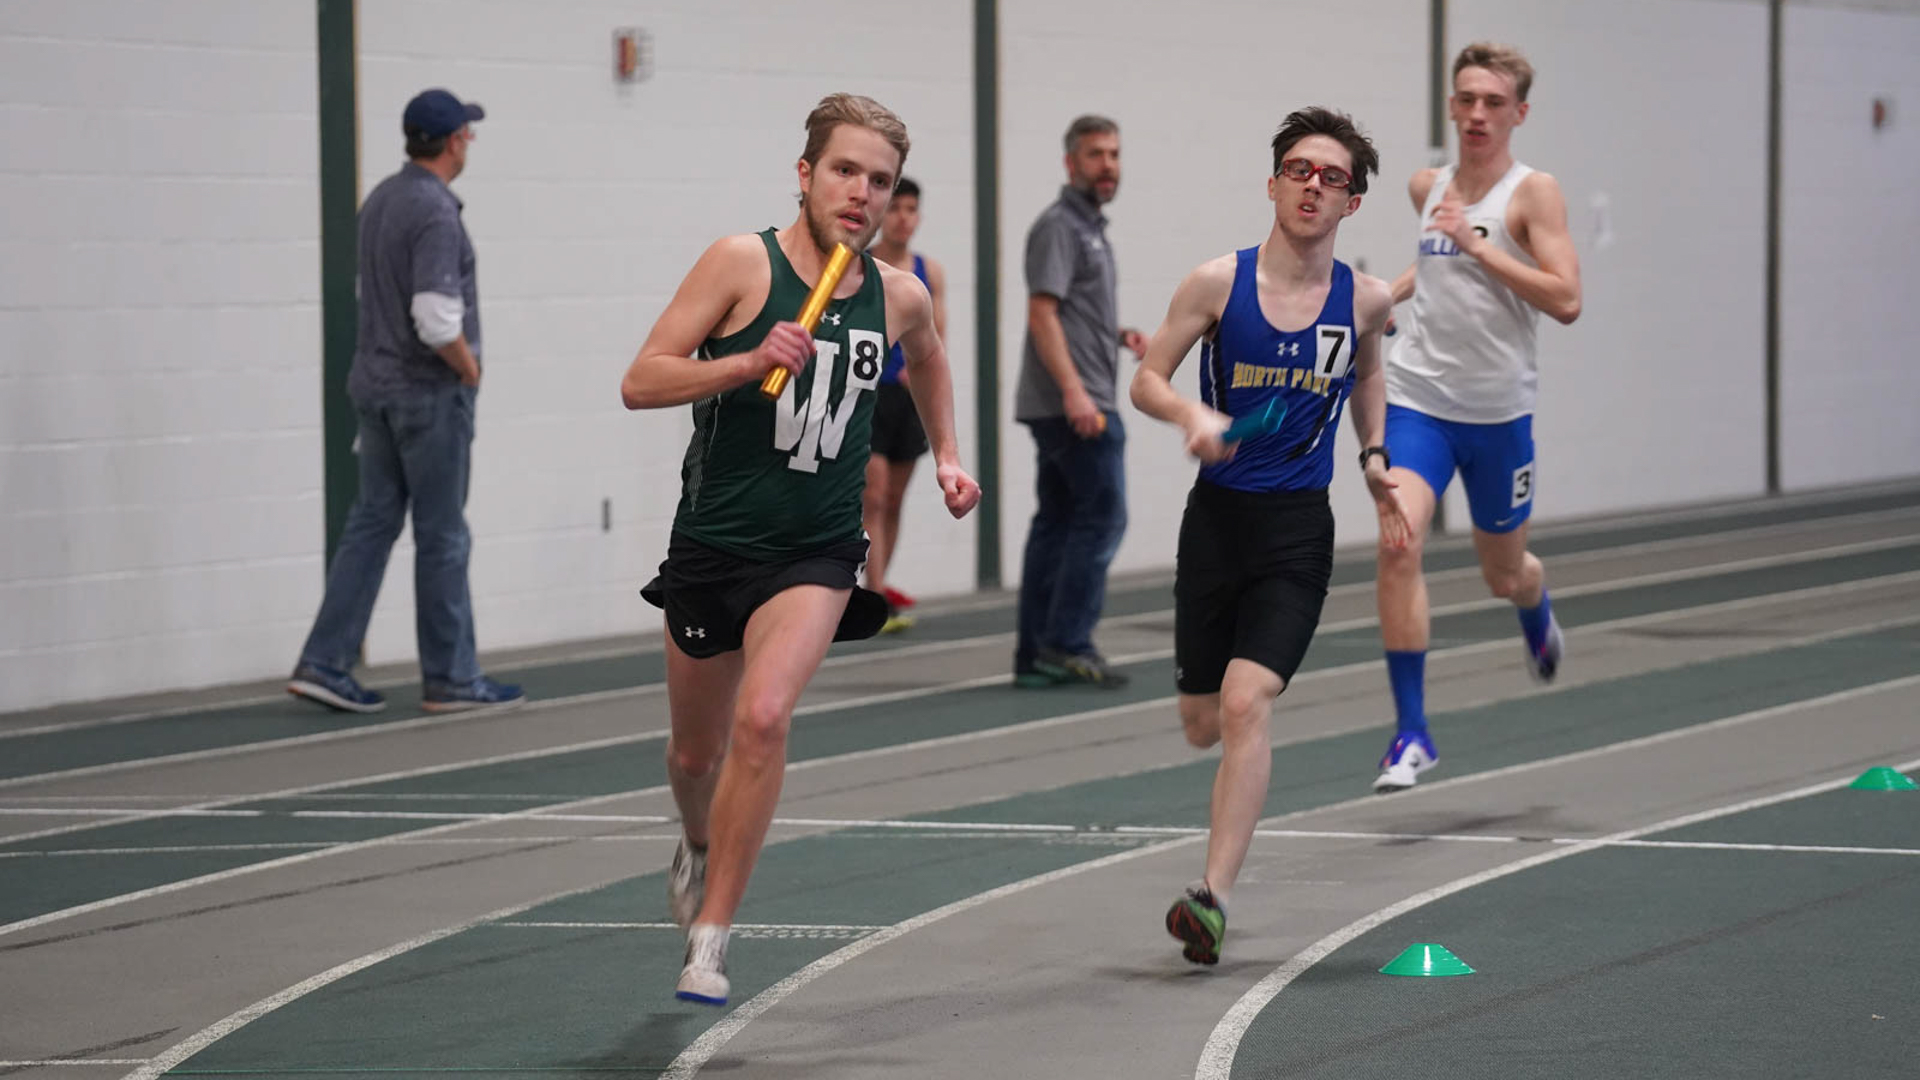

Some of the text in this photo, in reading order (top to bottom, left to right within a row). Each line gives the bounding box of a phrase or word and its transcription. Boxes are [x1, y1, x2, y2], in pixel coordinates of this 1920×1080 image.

[853, 340, 879, 381] 8
[1322, 330, 1345, 373] 7
[1231, 361, 1288, 389] NORTH
[1516, 470, 1530, 499] 3
